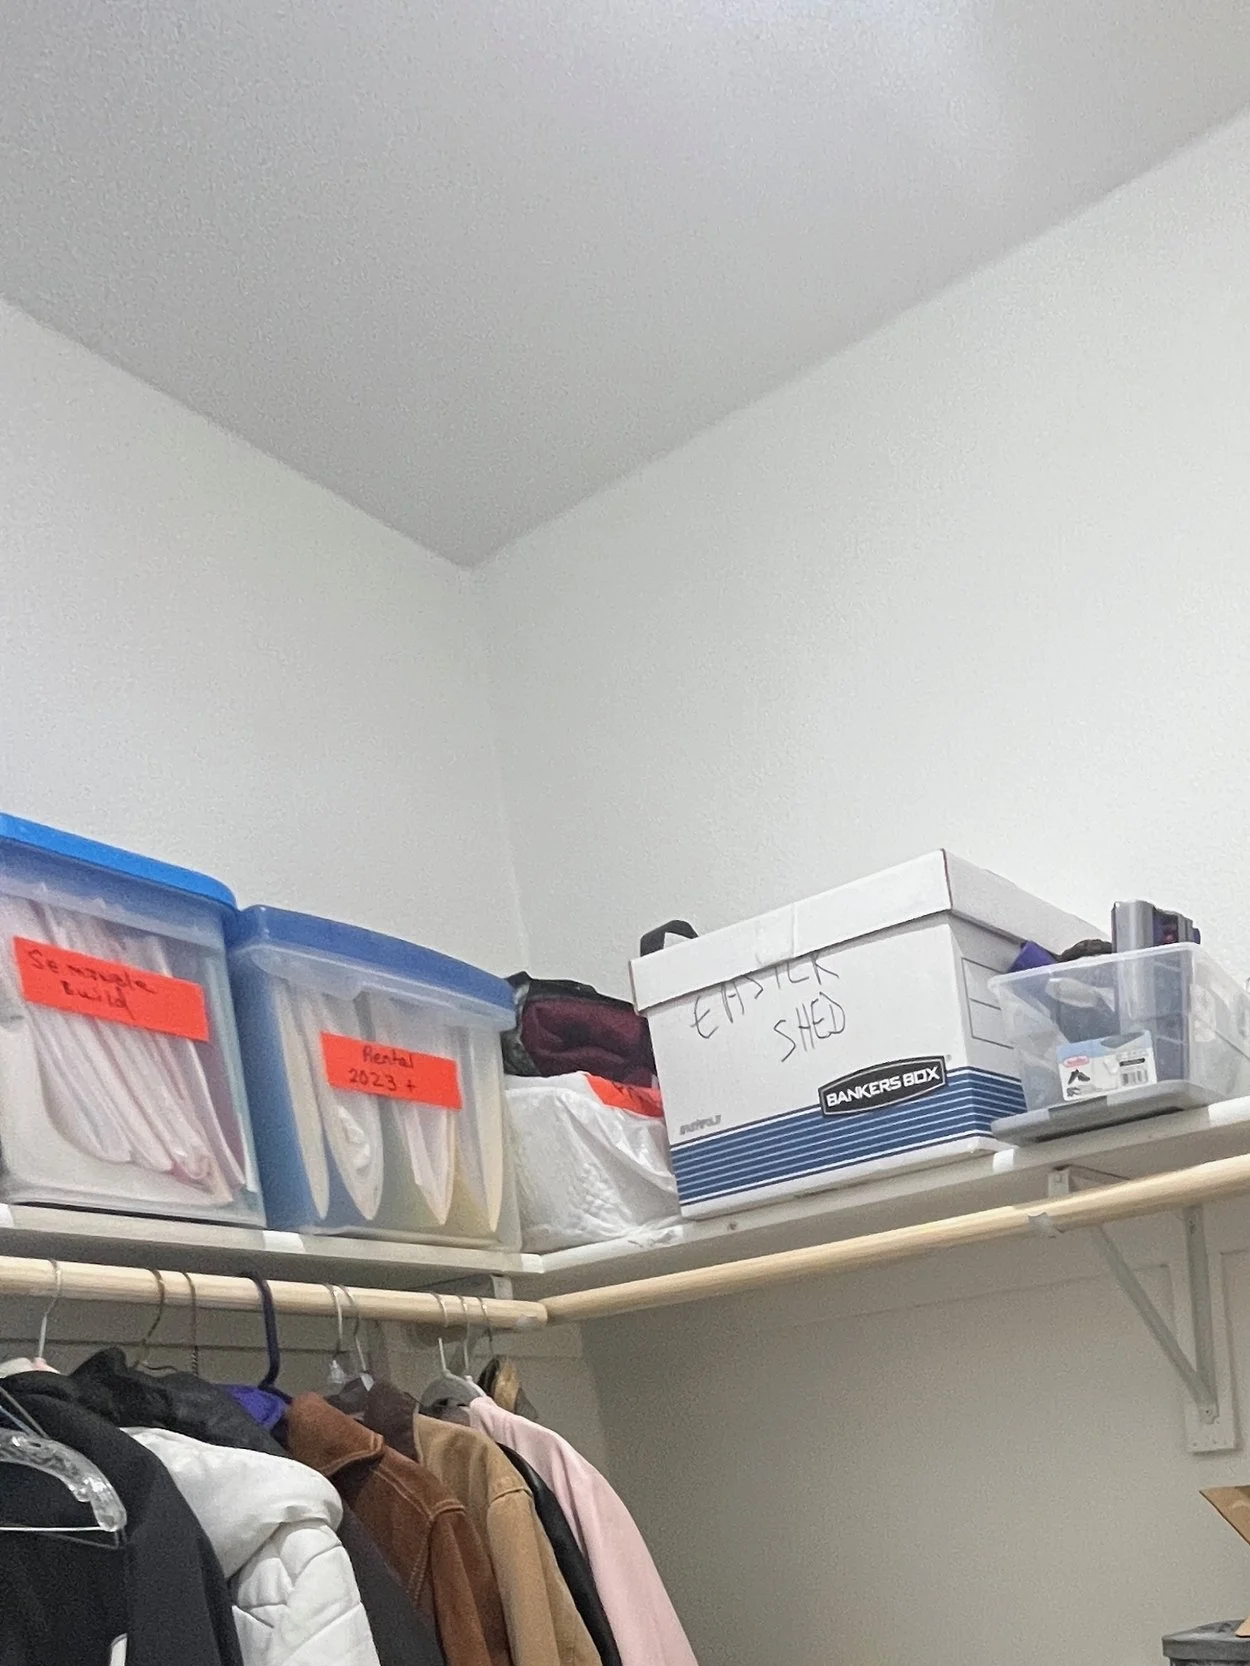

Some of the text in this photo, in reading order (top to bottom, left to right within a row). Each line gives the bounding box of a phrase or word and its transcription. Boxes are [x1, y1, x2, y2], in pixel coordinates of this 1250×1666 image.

[773, 991, 846, 1063] SHED
[363, 1044, 414, 1069] Rental
[349, 1069, 397, 1092] 2023
[826, 1065, 940, 1107] BANKERS BOX
